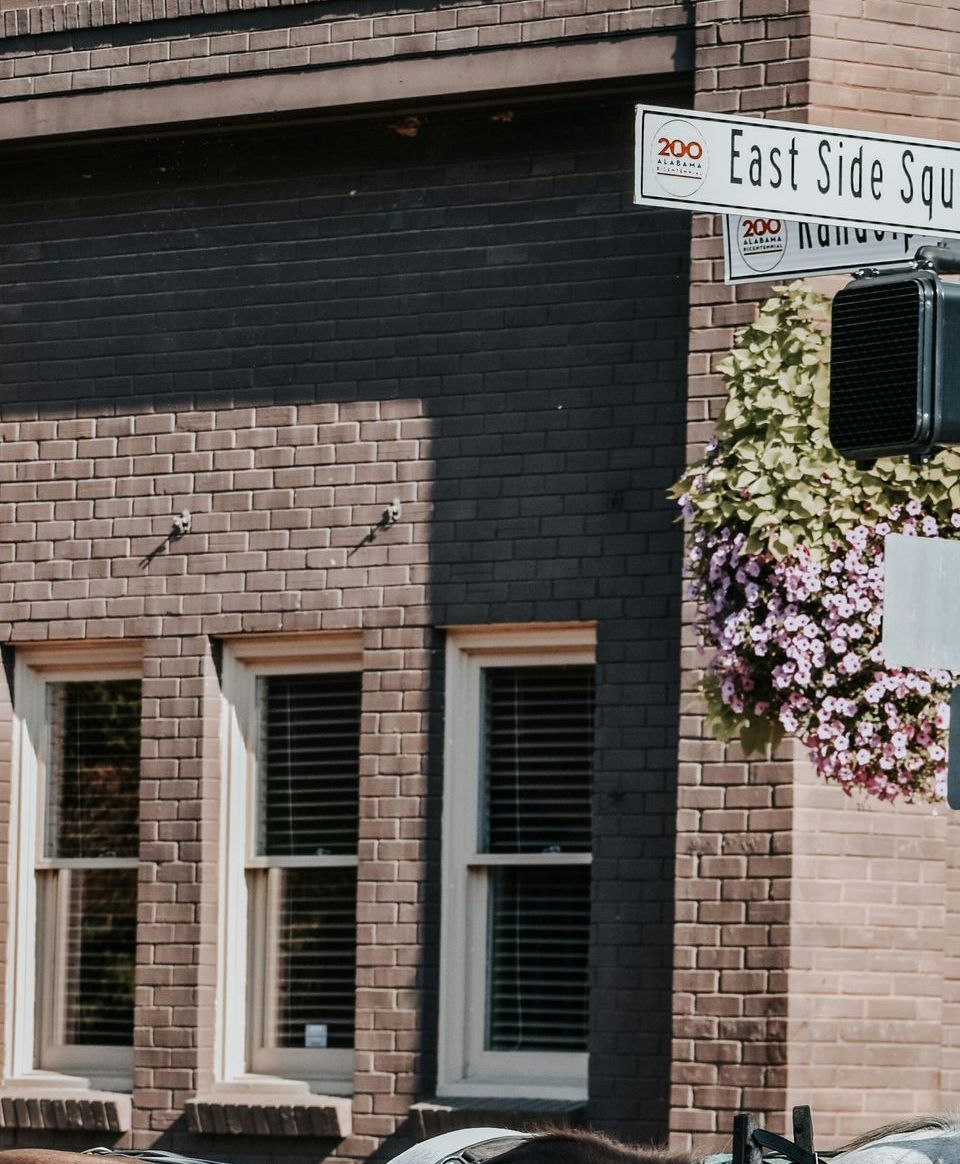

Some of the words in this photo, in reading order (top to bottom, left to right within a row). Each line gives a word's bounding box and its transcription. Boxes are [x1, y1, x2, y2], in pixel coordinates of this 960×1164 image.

[657, 137, 703, 160] 200
[657, 158, 702, 169] ALABAMA
[730, 129, 799, 191] East
[817, 139, 883, 200] Side
[742, 218, 782, 238] 200
[743, 236, 782, 245] ALABAMA
